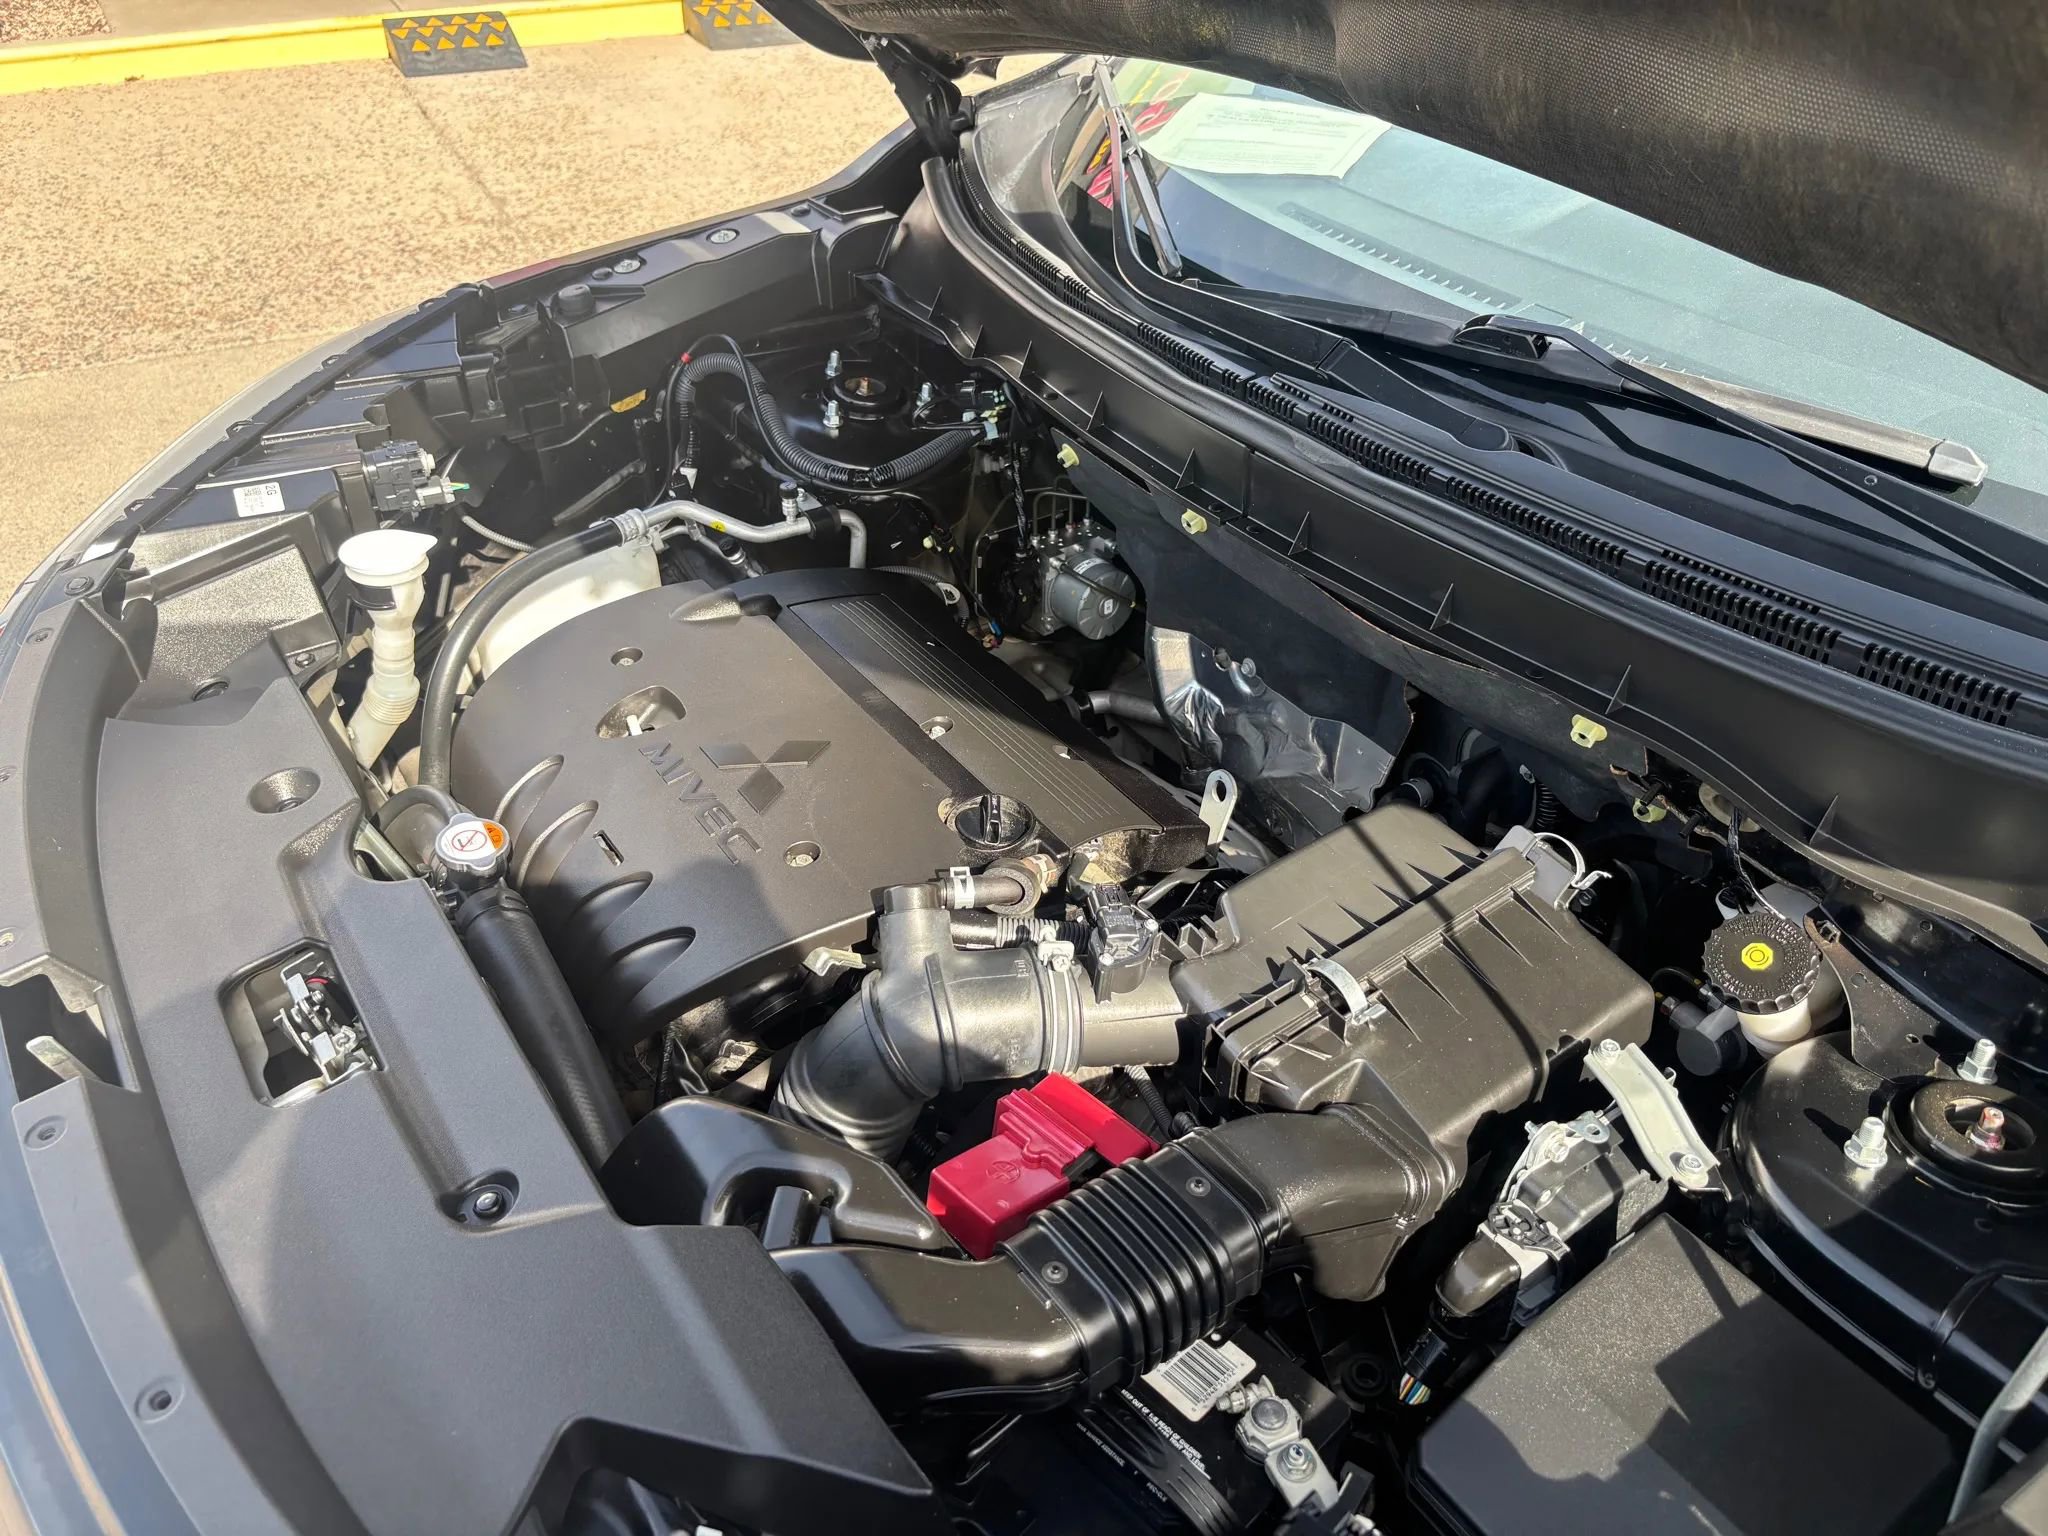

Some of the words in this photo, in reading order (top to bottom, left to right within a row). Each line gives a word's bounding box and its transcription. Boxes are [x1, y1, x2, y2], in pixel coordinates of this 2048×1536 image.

[638, 742, 762, 865] MIVEC
[1121, 1389, 1134, 1400] KEEP
[1132, 1398, 1143, 1409] OUT
[1141, 1406, 1150, 1415] OF
[1172, 1432, 1181, 1441] OF
